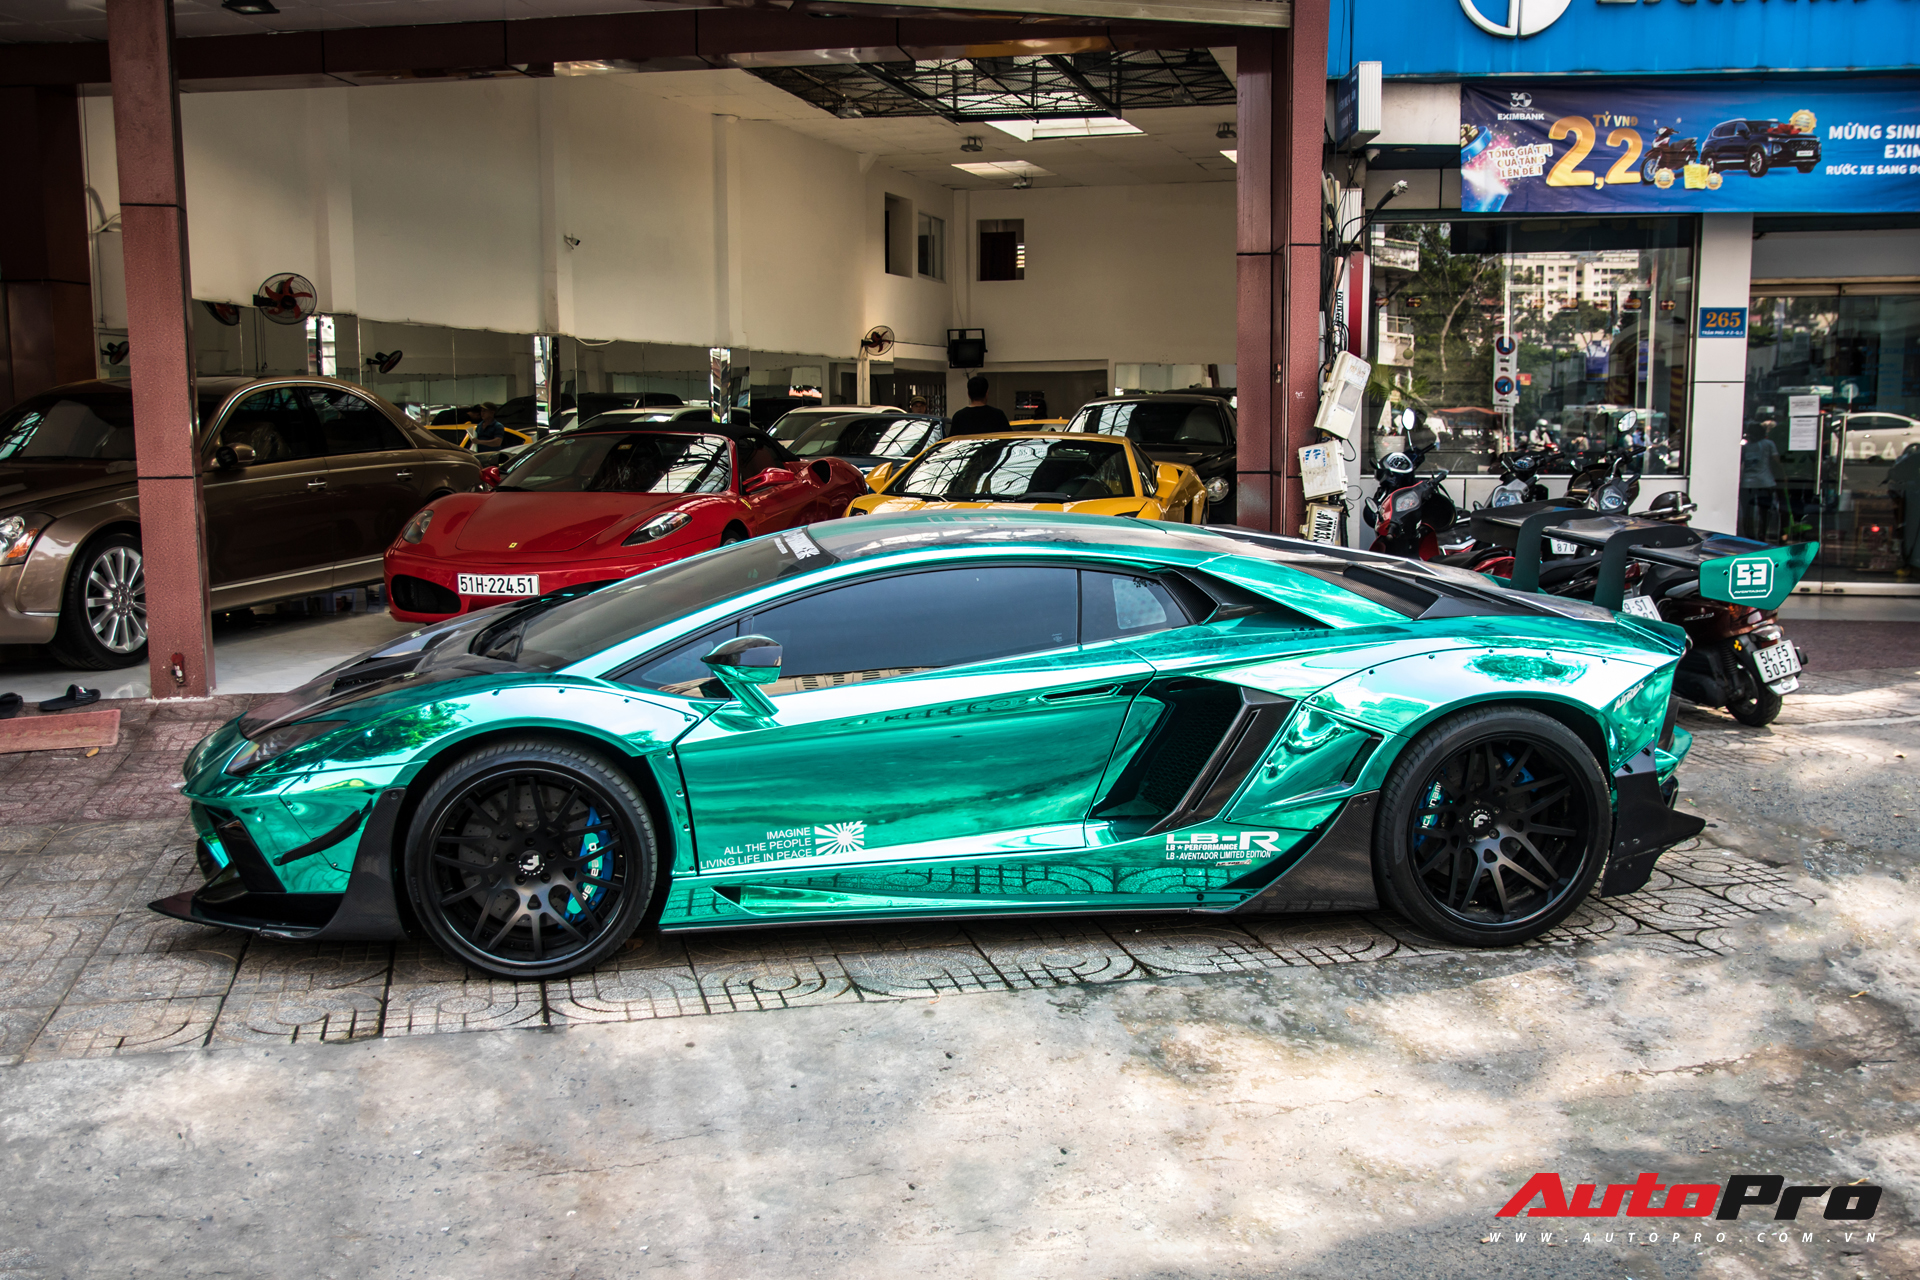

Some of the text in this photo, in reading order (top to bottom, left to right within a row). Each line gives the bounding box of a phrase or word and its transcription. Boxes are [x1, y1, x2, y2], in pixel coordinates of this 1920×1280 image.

[1497, 113, 1545, 121] EXIMBANK
[1613, 115, 1638, 127] VNĐ
[1829, 122, 1882, 140] MỪNG
[1546, 115, 1643, 190] 2,2
[1826, 163, 1858, 175] RƯỚC
[1860, 165, 1875, 175] XE
[1876, 165, 1907, 175] SANG
[1705, 312, 1741, 328] 265
[1736, 563, 1767, 586] 53
[460, 576, 533, 594] 51H-224.51
[1760, 644, 1789, 665] 54-F5
[1765, 658, 1792, 678] 5057
[766, 827, 811, 840] IMAGINE
[724, 838, 812, 855] ALL THE PEOPLE
[1184, 843, 1238, 851] PERFORMANCE
[1220, 851, 1244, 859] LIMITED
[1246, 850, 1271, 858] EDITION
[700, 849, 812, 869] LIVING LIFE IN PEACE
